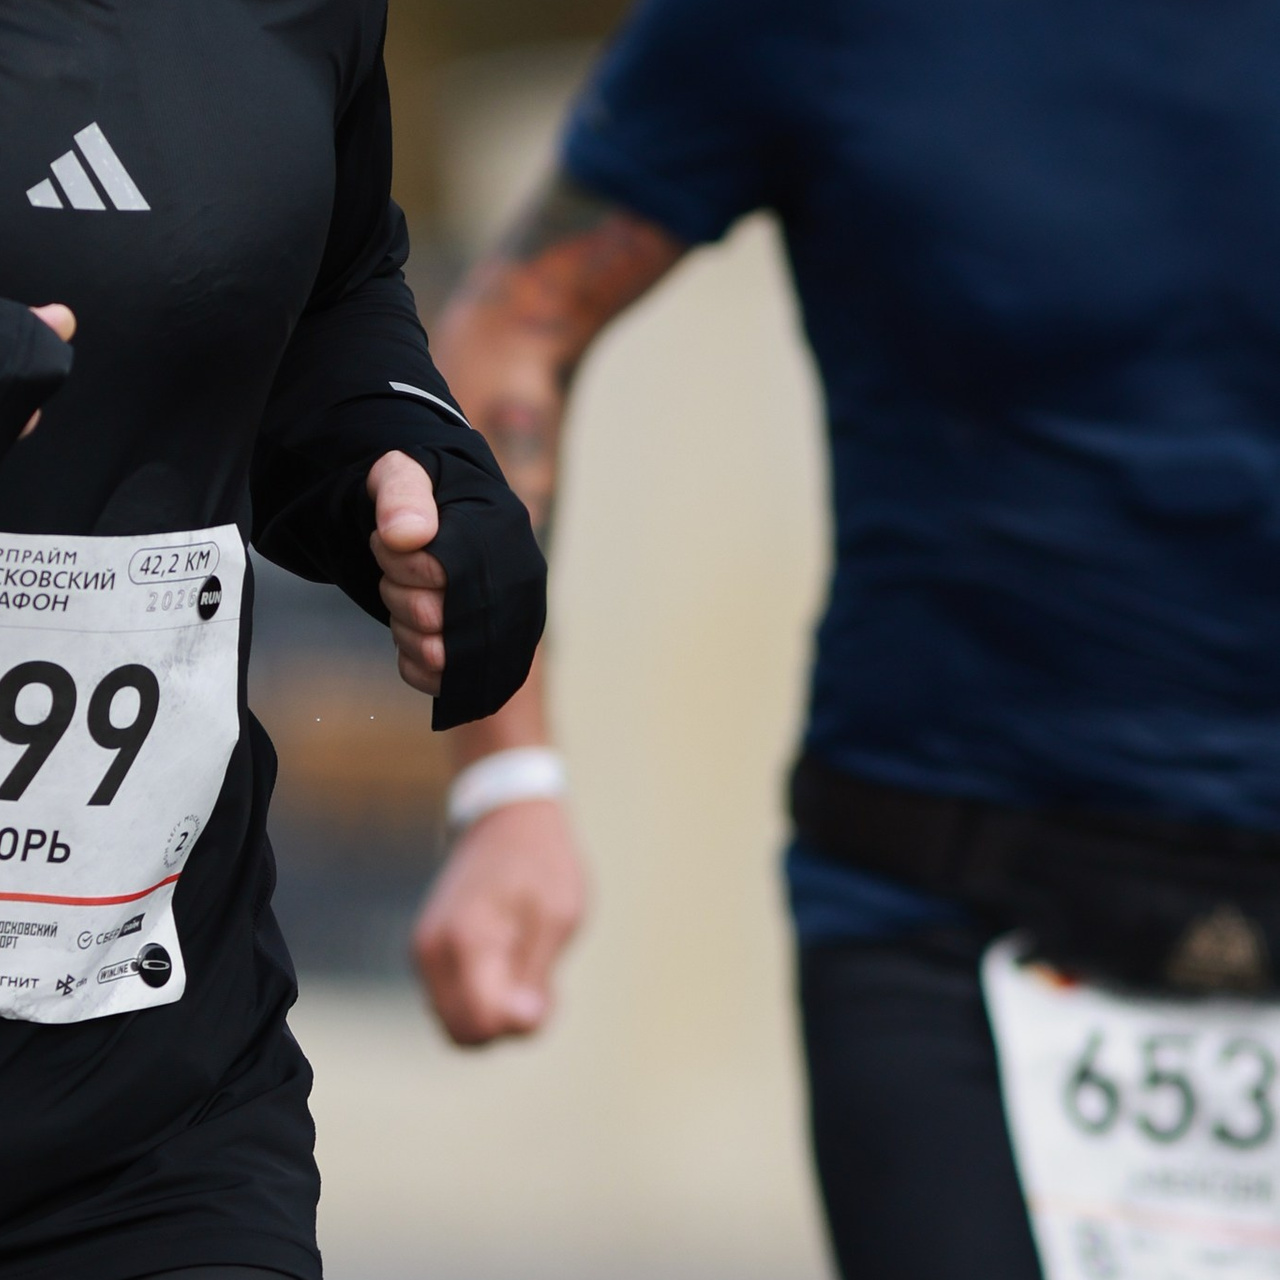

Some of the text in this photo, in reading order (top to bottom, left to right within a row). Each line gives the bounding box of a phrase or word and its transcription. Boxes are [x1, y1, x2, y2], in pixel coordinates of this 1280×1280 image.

[139, 549, 211, 577] 42,2 КМ
[1064, 1028, 1276, 1153] 653
